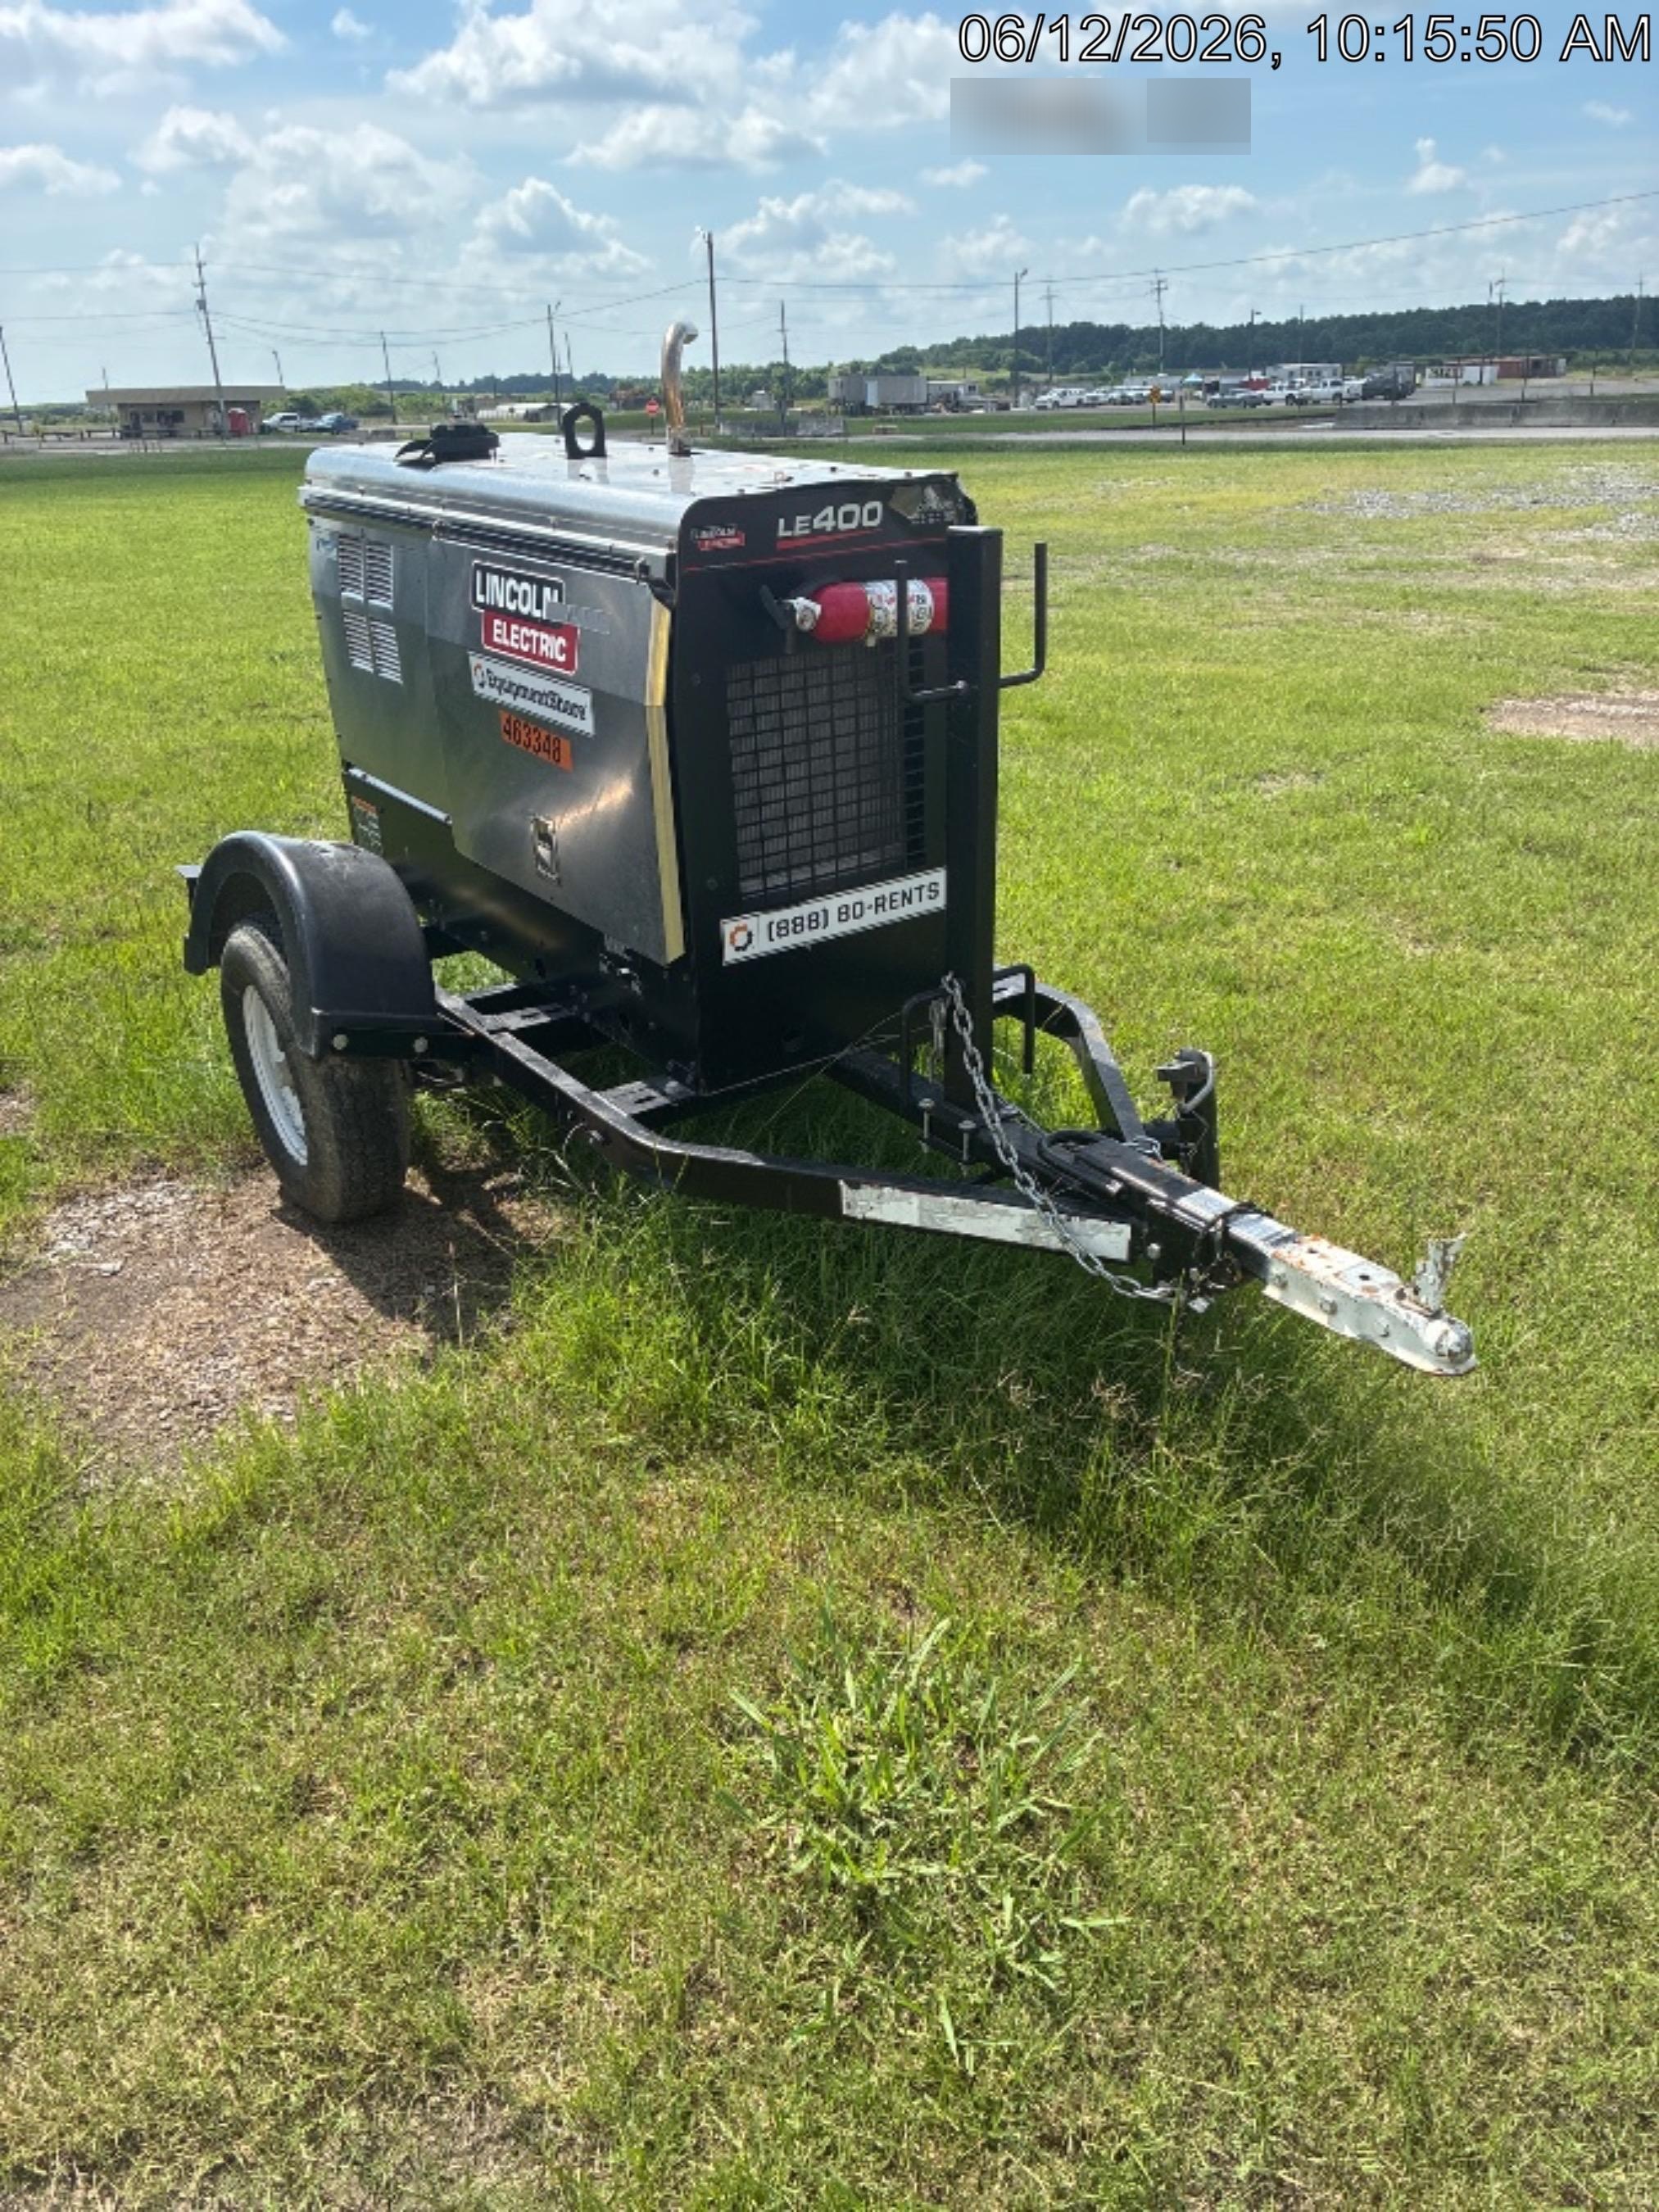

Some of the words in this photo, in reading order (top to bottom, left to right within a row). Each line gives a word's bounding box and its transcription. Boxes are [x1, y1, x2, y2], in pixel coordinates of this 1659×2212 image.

[778, 501, 882, 536] LE400
[493, 619, 566, 661] ELECTRIC
[503, 715, 560, 763] 463348
[767, 905, 829, 941] (888)
